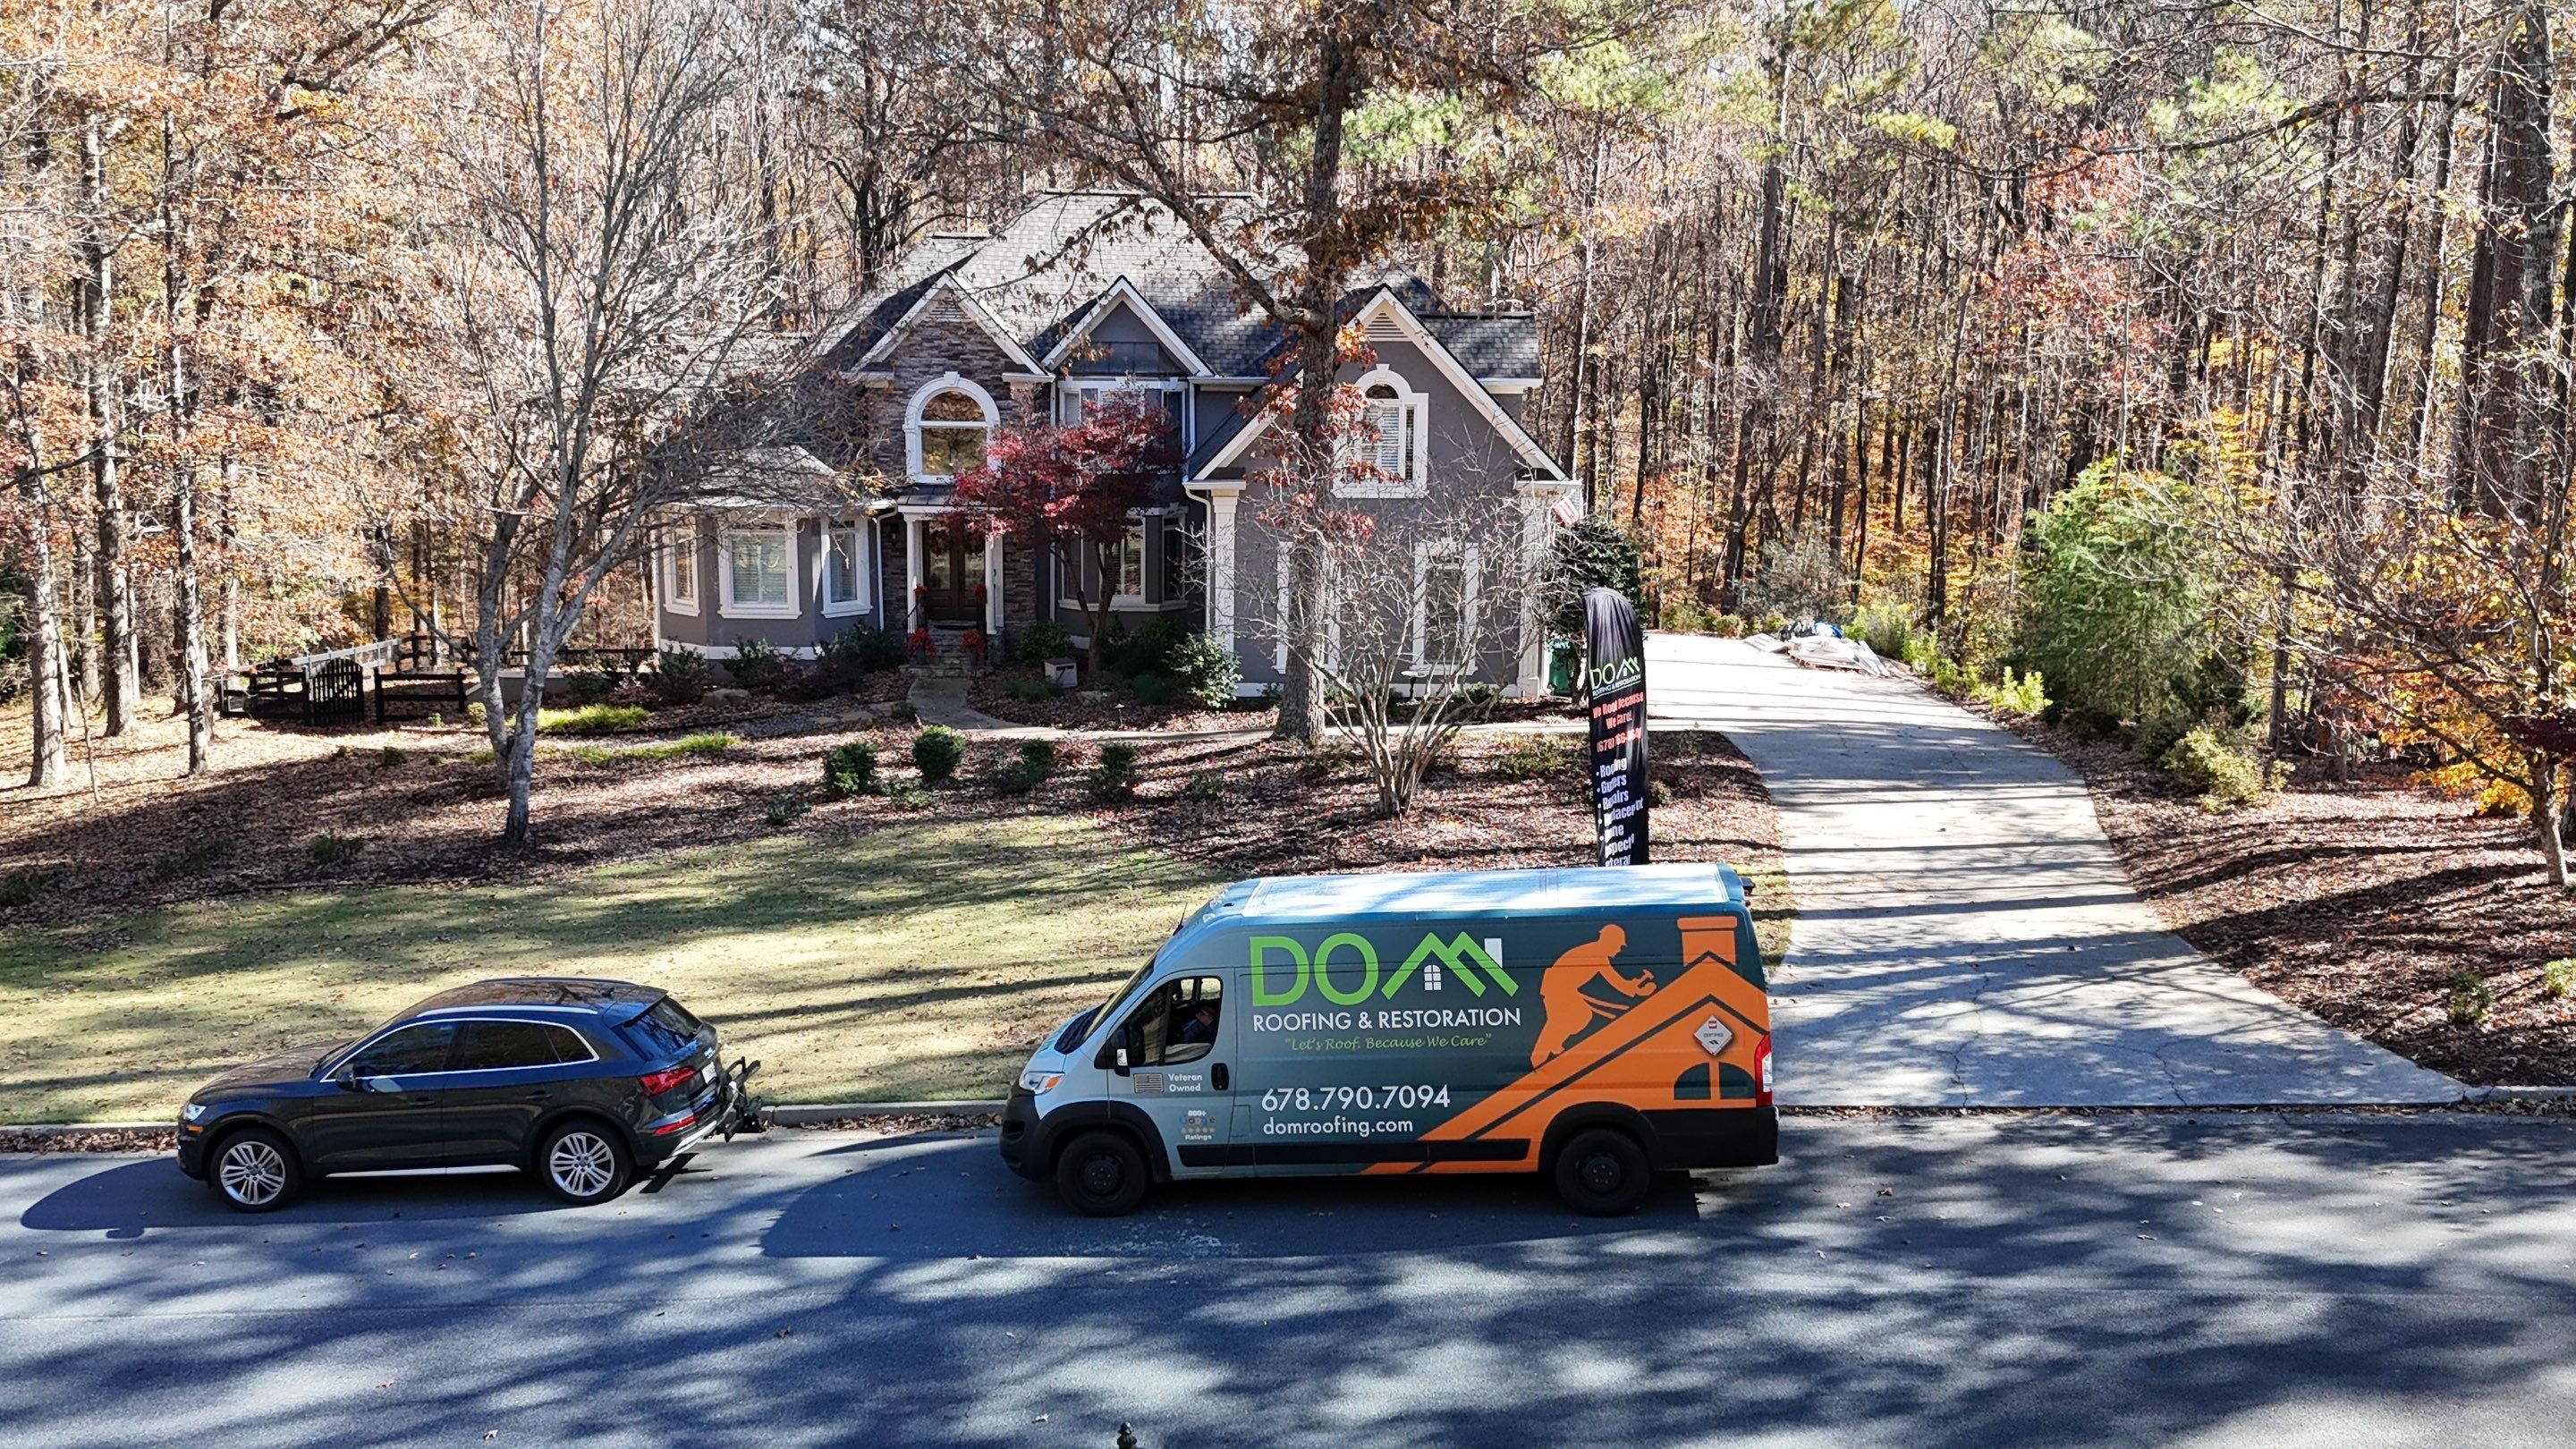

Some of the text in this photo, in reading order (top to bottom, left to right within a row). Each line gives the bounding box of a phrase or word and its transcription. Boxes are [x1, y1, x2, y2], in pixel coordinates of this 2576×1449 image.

[1250, 931, 1519, 1006] DOM
[1253, 1007, 1521, 1031] ROOFING & RESTORATION
[1366, 1035, 1424, 1049] Because
[1427, 1035, 1449, 1048] We
[1168, 1073, 1202, 1081] Veteran
[1169, 1083, 1201, 1092] Owned
[1261, 1085, 1451, 1112] 678.790.7094
[1263, 1115, 1413, 1138] domroofing.com
